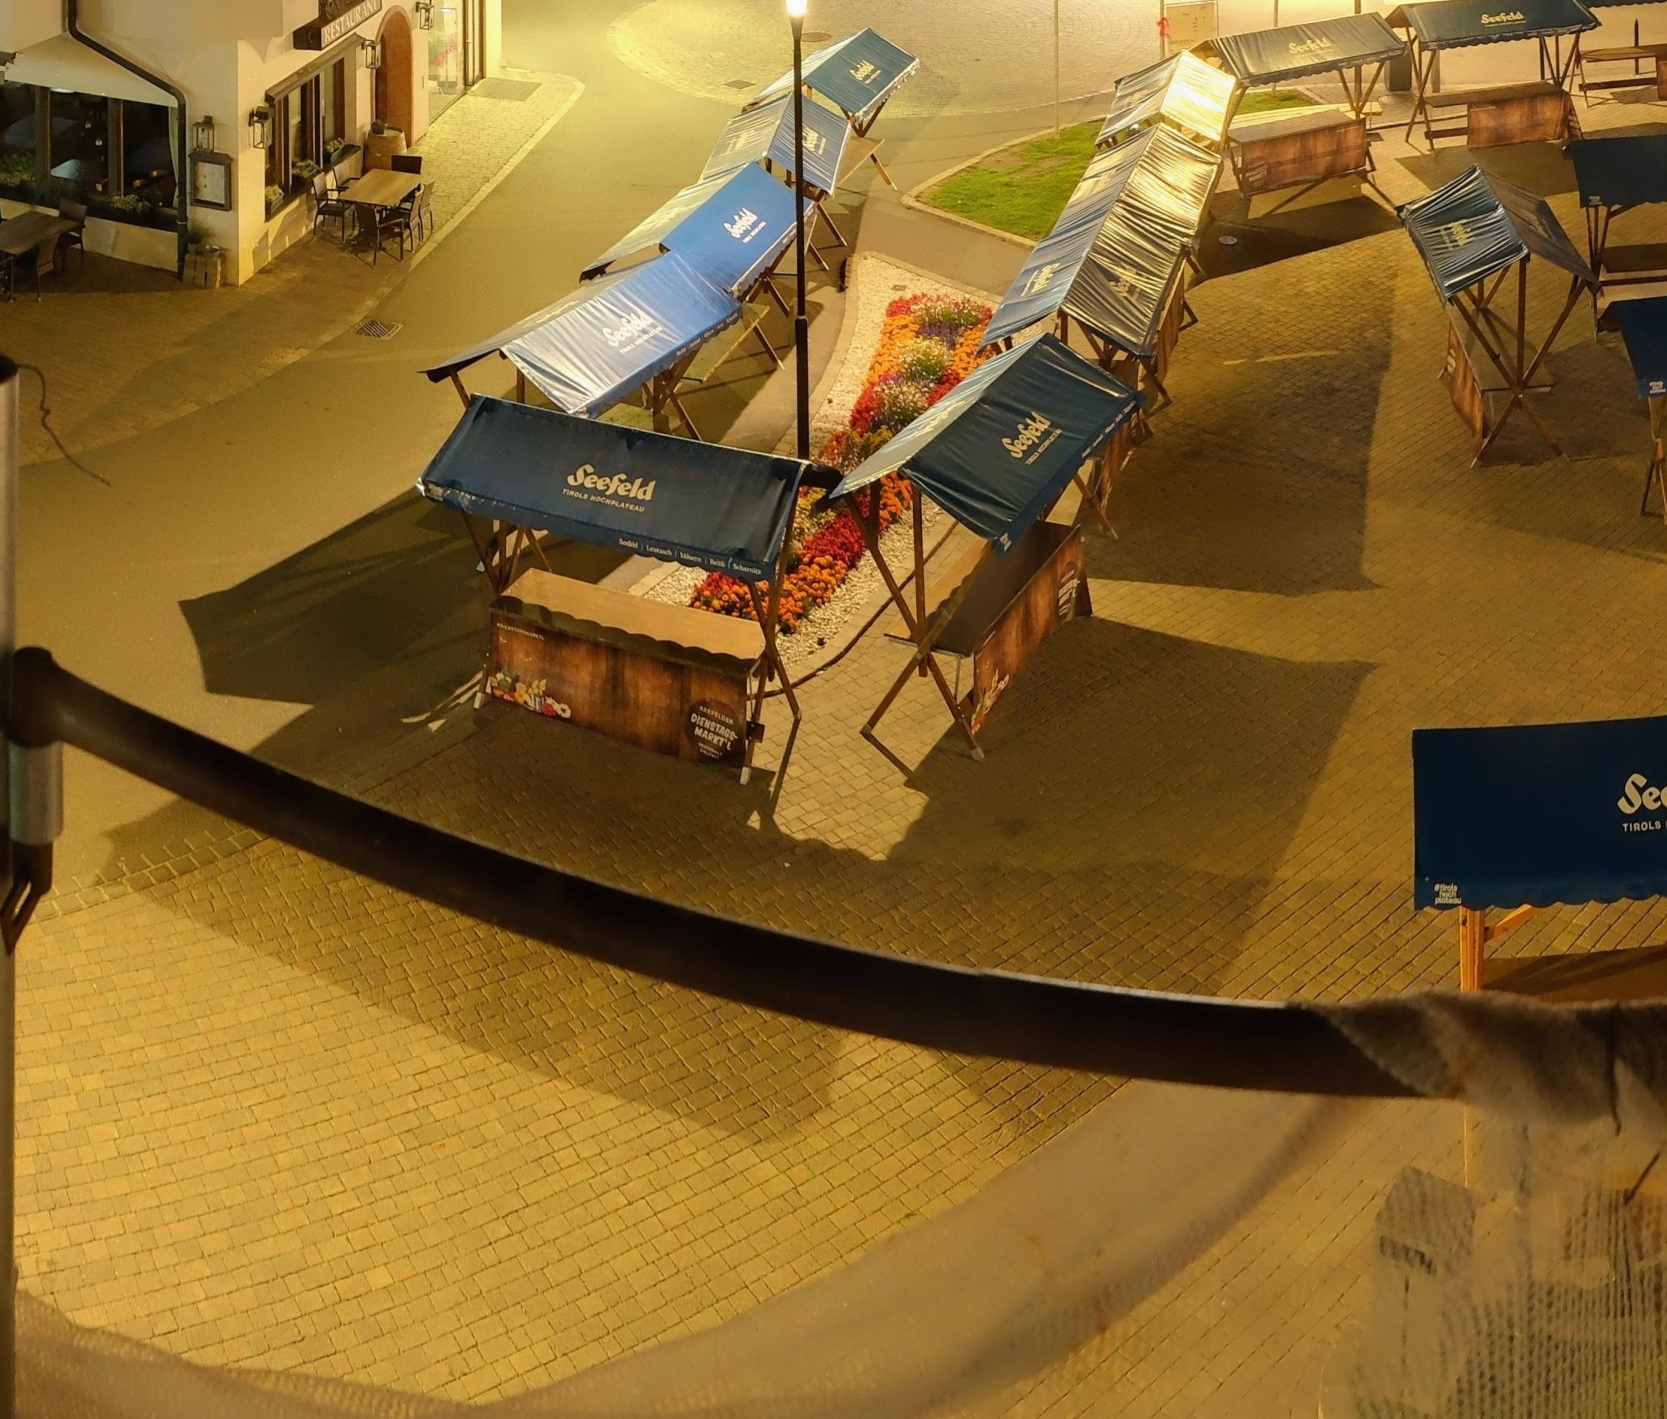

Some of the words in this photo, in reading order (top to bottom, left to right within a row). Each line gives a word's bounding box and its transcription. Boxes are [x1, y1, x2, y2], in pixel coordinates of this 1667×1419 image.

[1480, 9, 1524, 25] Seefeld
[1288, 37, 1332, 54] Seefeld
[602, 309, 654, 347] Seefeld
[1001, 409, 1052, 459] Seefeld
[566, 463, 656, 501] Seefeld
[562, 487, 589, 500] TIROLS
[590, 495, 646, 513] HOCHPLATEAU
[618, 537, 639, 550] Seefeld
[646, 544, 673, 557] Leutasch
[700, 705, 734, 725] SEEFELDER
[690, 713, 738, 741] DIENSTAGS-
[694, 727, 732, 751] MARKT'L
[1622, 820, 1662, 833] TIROLS
[1434, 883, 1458, 893] #tirols
[1440, 889, 1458, 899] hoch
[1434, 895, 1462, 905] plateau
